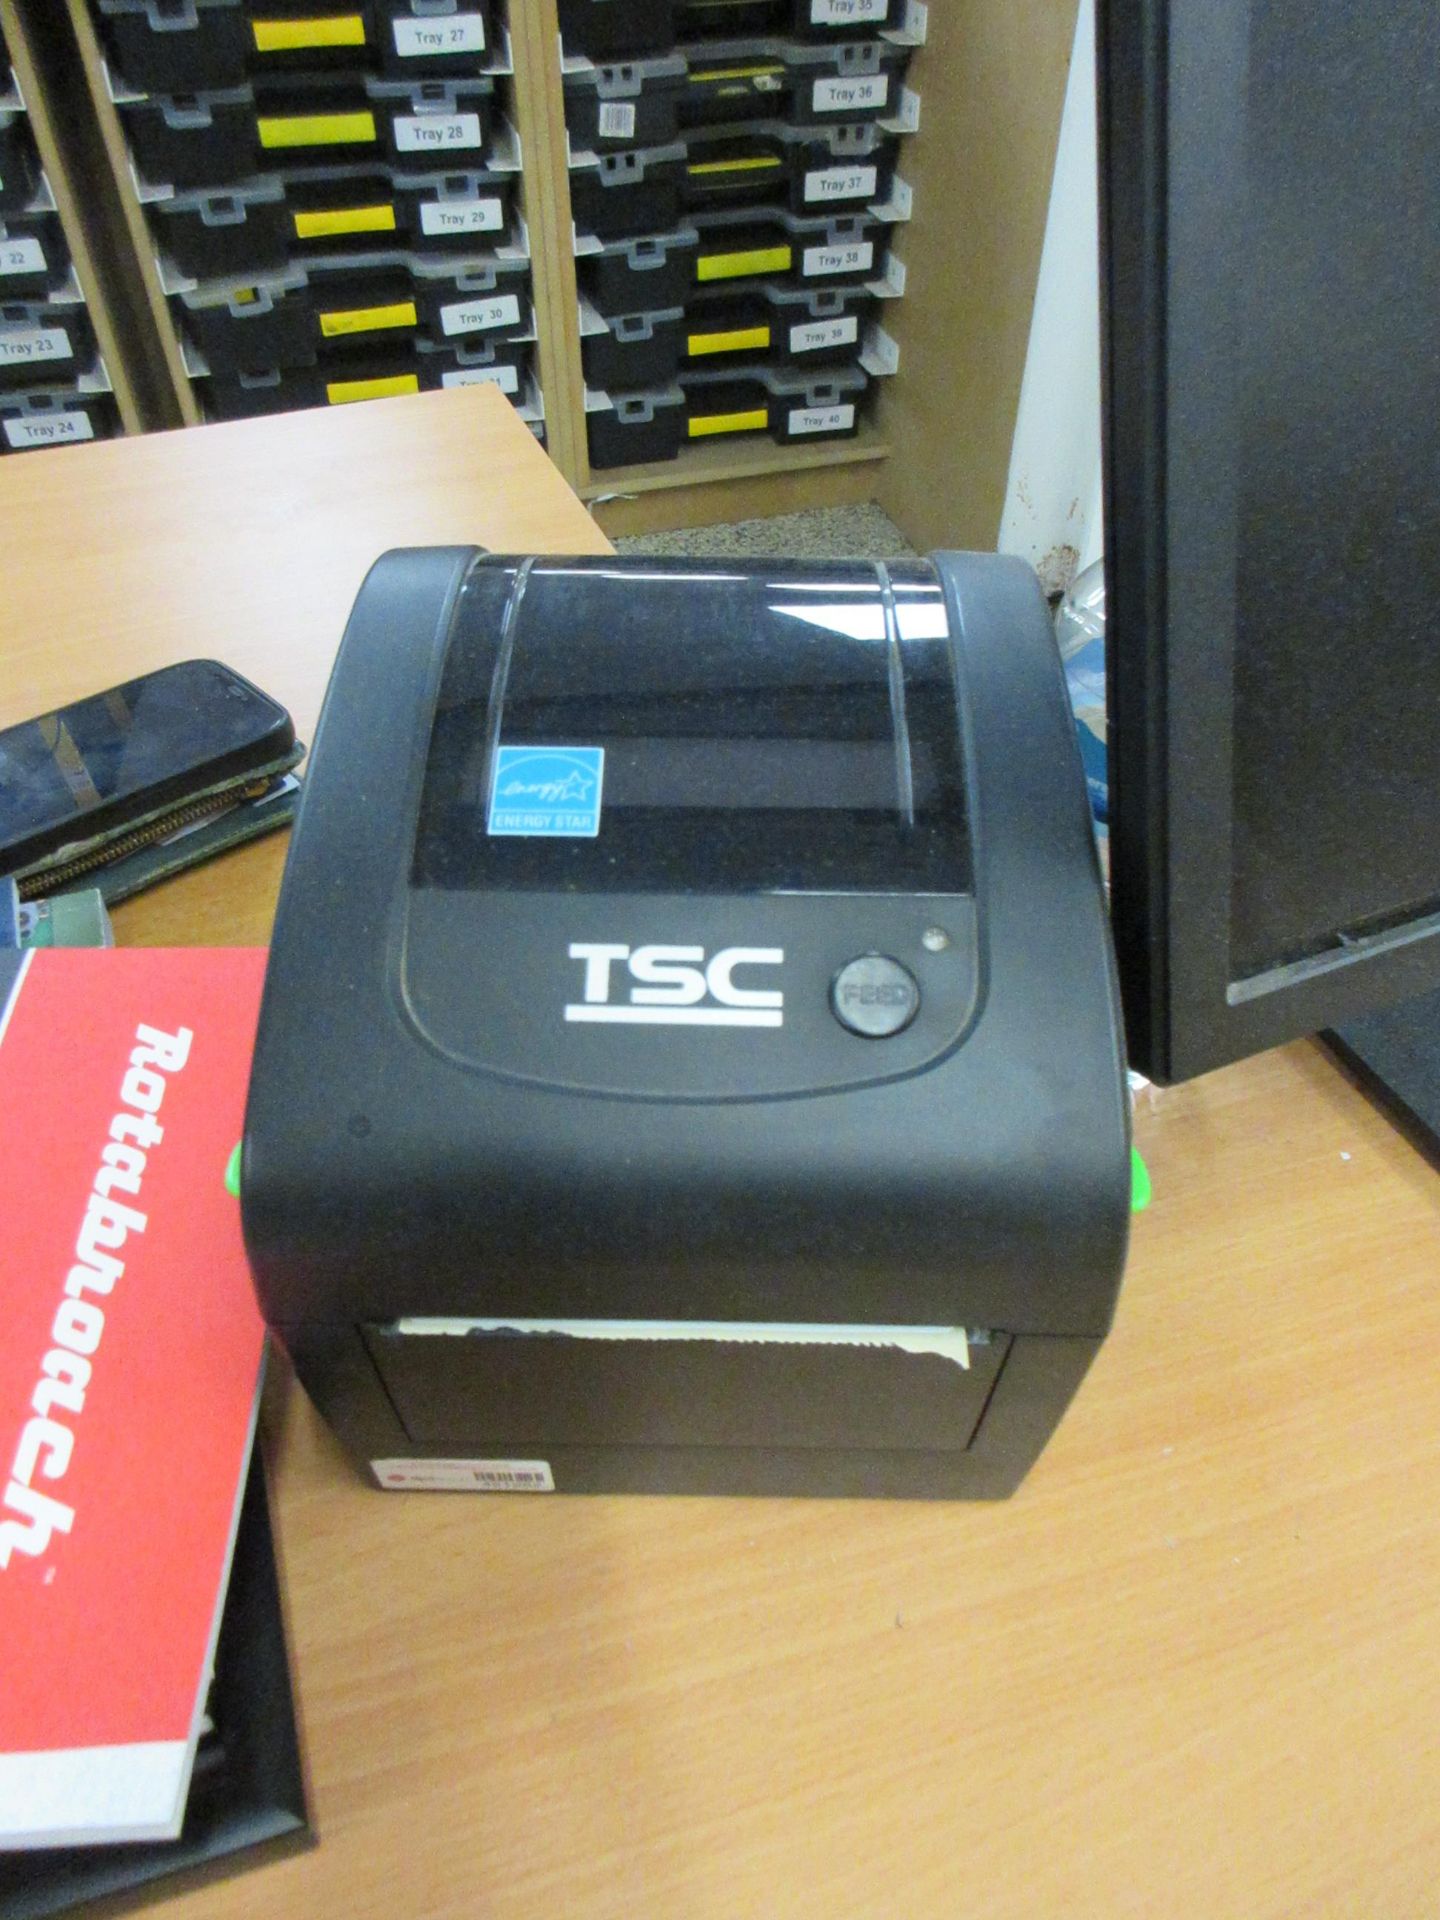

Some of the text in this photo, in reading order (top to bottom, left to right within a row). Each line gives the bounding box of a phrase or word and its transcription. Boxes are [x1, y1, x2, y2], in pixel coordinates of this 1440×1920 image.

[828, 0, 873, 14] Tray 35
[415, 29, 464, 45] Tray 27
[828, 85, 873, 103] Tray 36
[413, 126, 463, 142] Tray 28
[820, 176, 862, 193] Tray 37
[439, 211, 485, 226] Tray 29
[10, 252, 24, 265] 22
[818, 255, 842, 267] Tray
[459, 308, 503, 324] Tray 30
[805, 333, 826, 343] Tray
[1, 339, 54, 356] Tray 23
[803, 414, 840, 426] Tray 40
[23, 420, 75, 438] Tray 24
[495, 814, 591, 829] ENERGY STAR
[568, 943, 785, 1008] TSC
[843, 983, 907, 1006] FEED
[0, 1022, 194, 1571] Rotabroach
